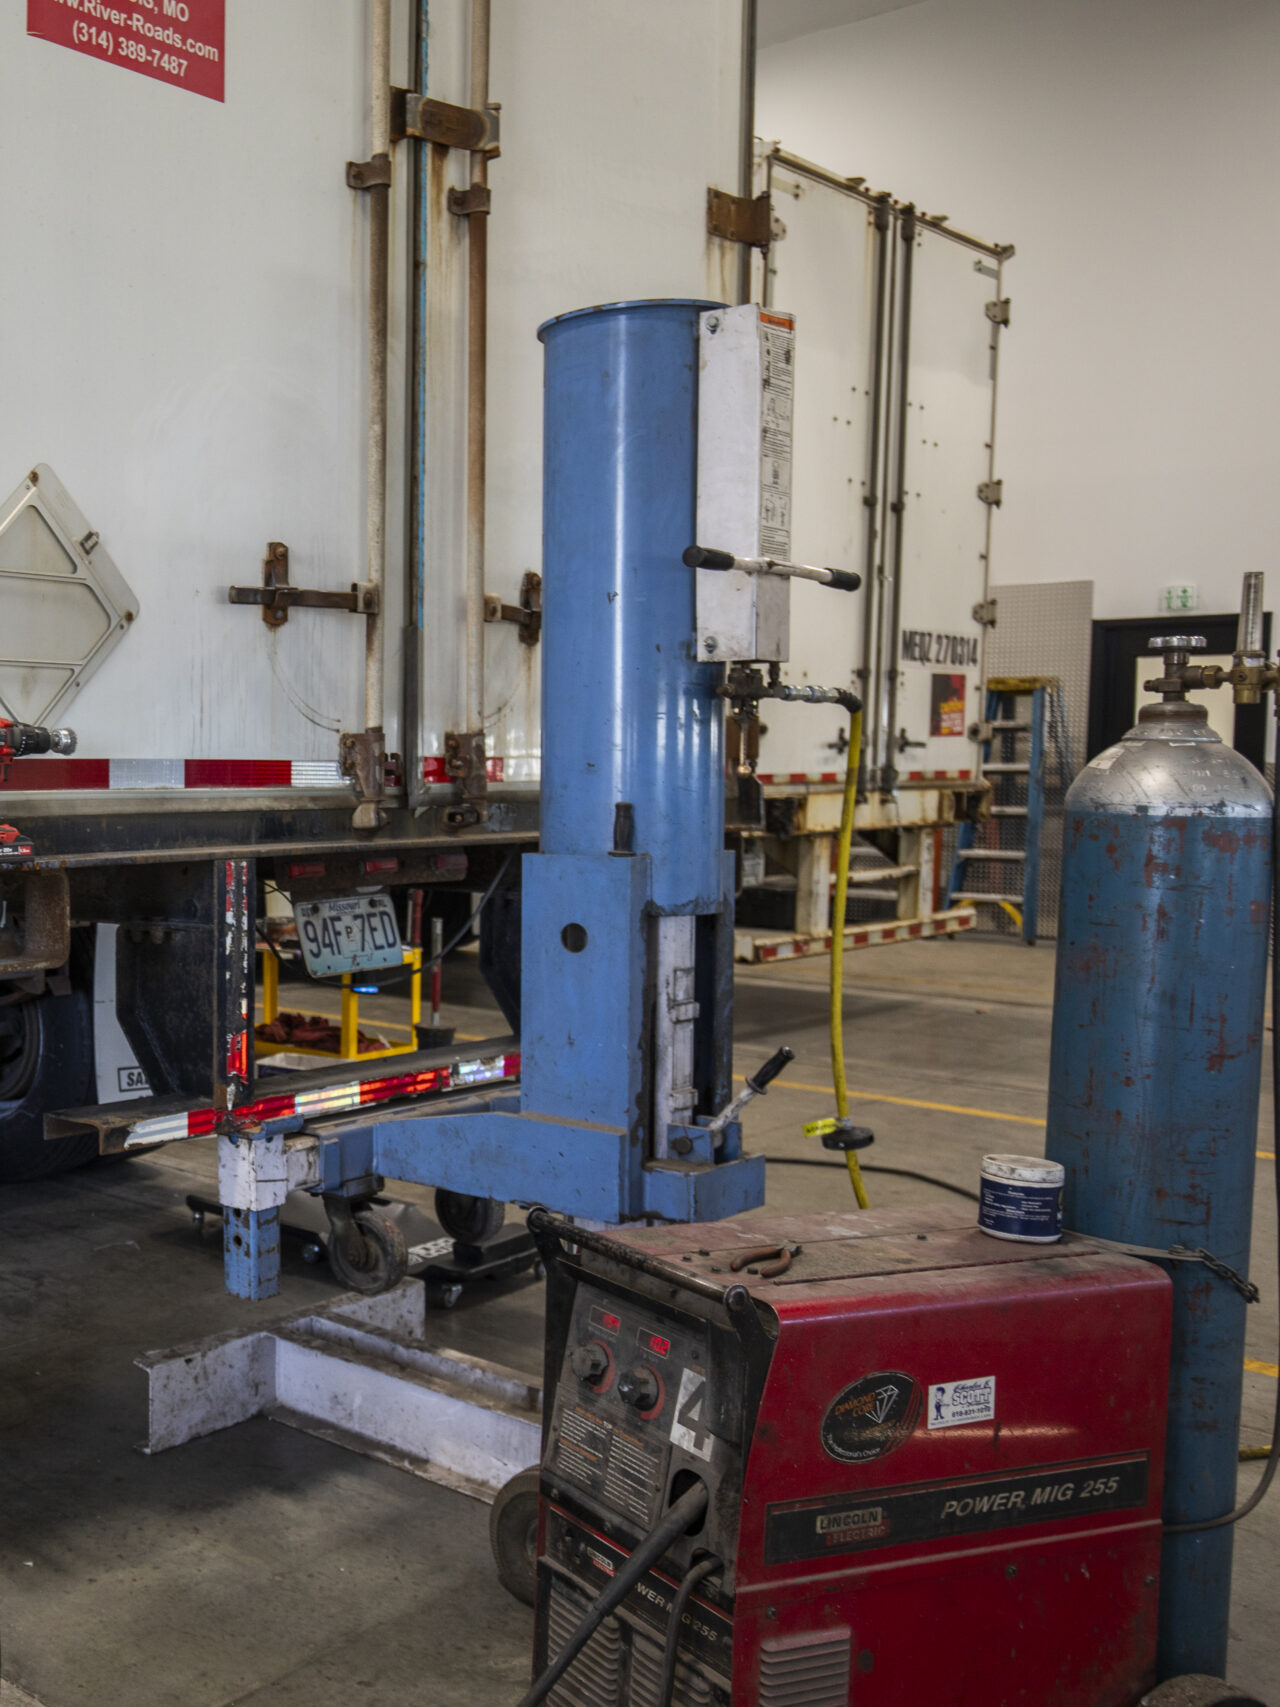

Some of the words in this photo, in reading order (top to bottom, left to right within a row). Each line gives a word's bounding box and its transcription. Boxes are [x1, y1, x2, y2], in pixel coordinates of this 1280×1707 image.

[163, 0, 189, 22] MO
[73, 20, 114, 55] (314)
[118, 37, 188, 77] 389-7487
[303, 915, 342, 959] 94F
[352, 910, 397, 953] 7ED
[951, 1388, 991, 1407] SCOTT
[940, 1490, 1026, 1519] POWER
[1031, 1483, 1075, 1505] MIG
[1080, 1476, 1120, 1498] 255
[820, 1510, 878, 1530] LINCOLN
[635, 1582, 666, 1608] WER
